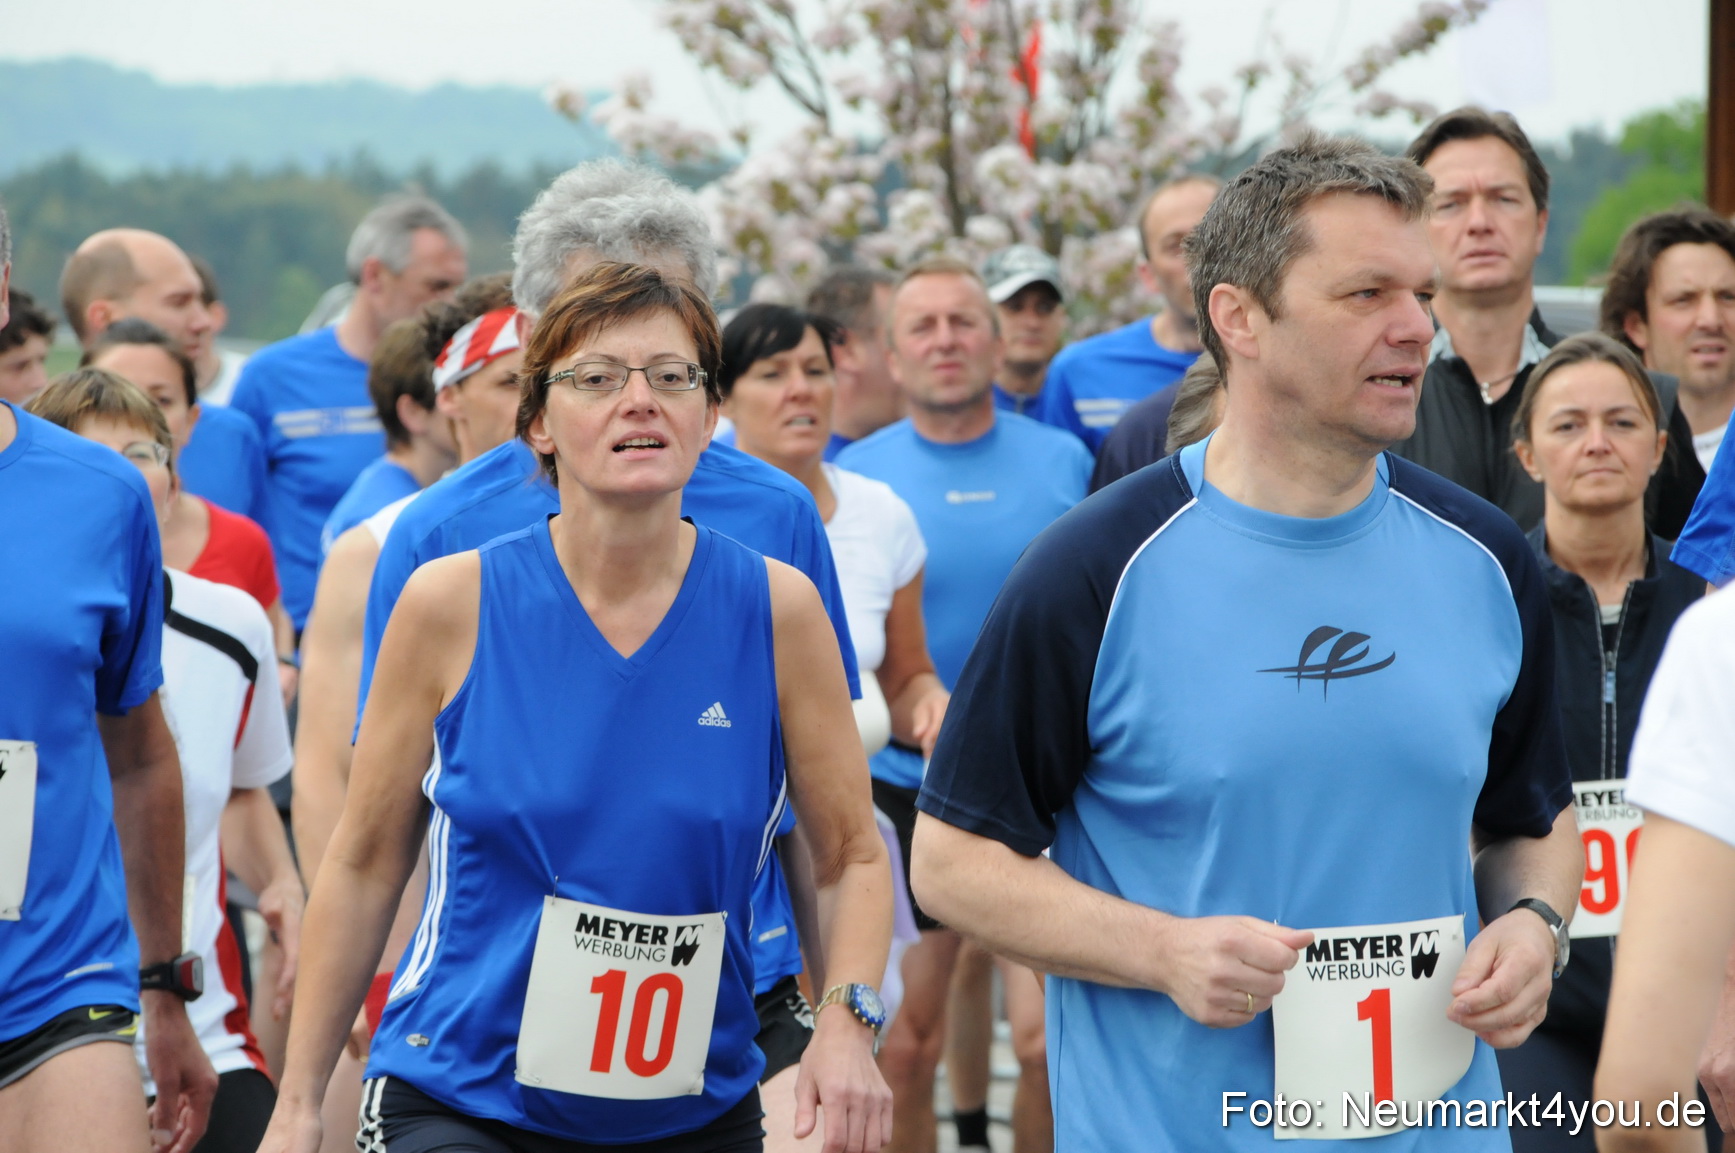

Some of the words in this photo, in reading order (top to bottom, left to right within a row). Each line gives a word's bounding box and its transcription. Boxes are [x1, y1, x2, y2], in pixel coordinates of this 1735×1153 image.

[698, 716, 731, 728] adidas
[1573, 788, 1626, 808] EYE
[1580, 827, 1643, 915] 9
[575, 912, 669, 945] MEYER
[574, 934, 666, 963] WERBUNG
[1305, 934, 1405, 963] MEYER
[1306, 960, 1406, 982] WERBUNG
[590, 968, 684, 1078] 10
[1357, 988, 1394, 1107] 1
